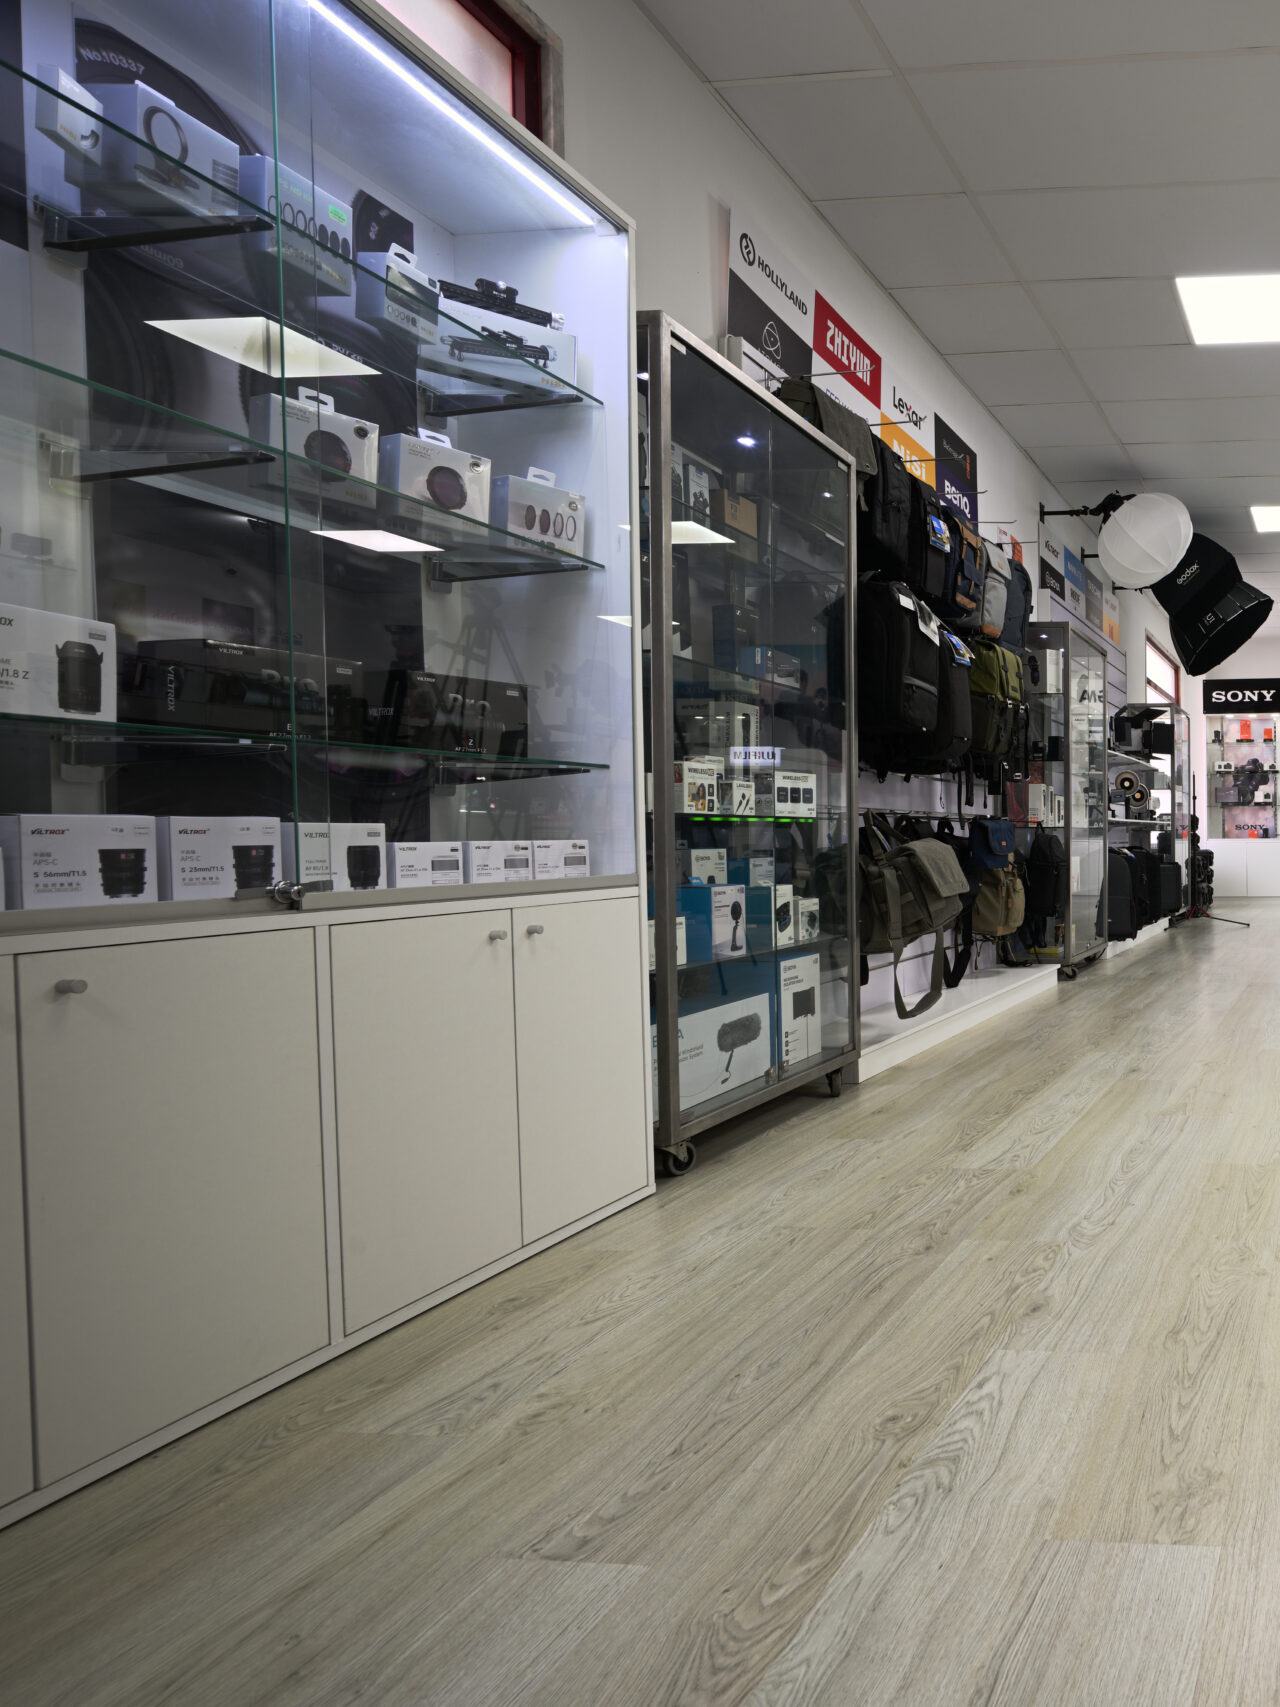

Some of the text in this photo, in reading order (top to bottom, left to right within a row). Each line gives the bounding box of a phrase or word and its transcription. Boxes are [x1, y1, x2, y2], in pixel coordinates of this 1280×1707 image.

[757, 255, 808, 316] HOLLYLAND
[826, 319, 871, 386] ZHIYUN
[893, 386, 922, 430] Lexar
[945, 480, 971, 519] BenQ
[1176, 562, 1200, 585] Godox
[1211, 689, 1276, 703] SONY
